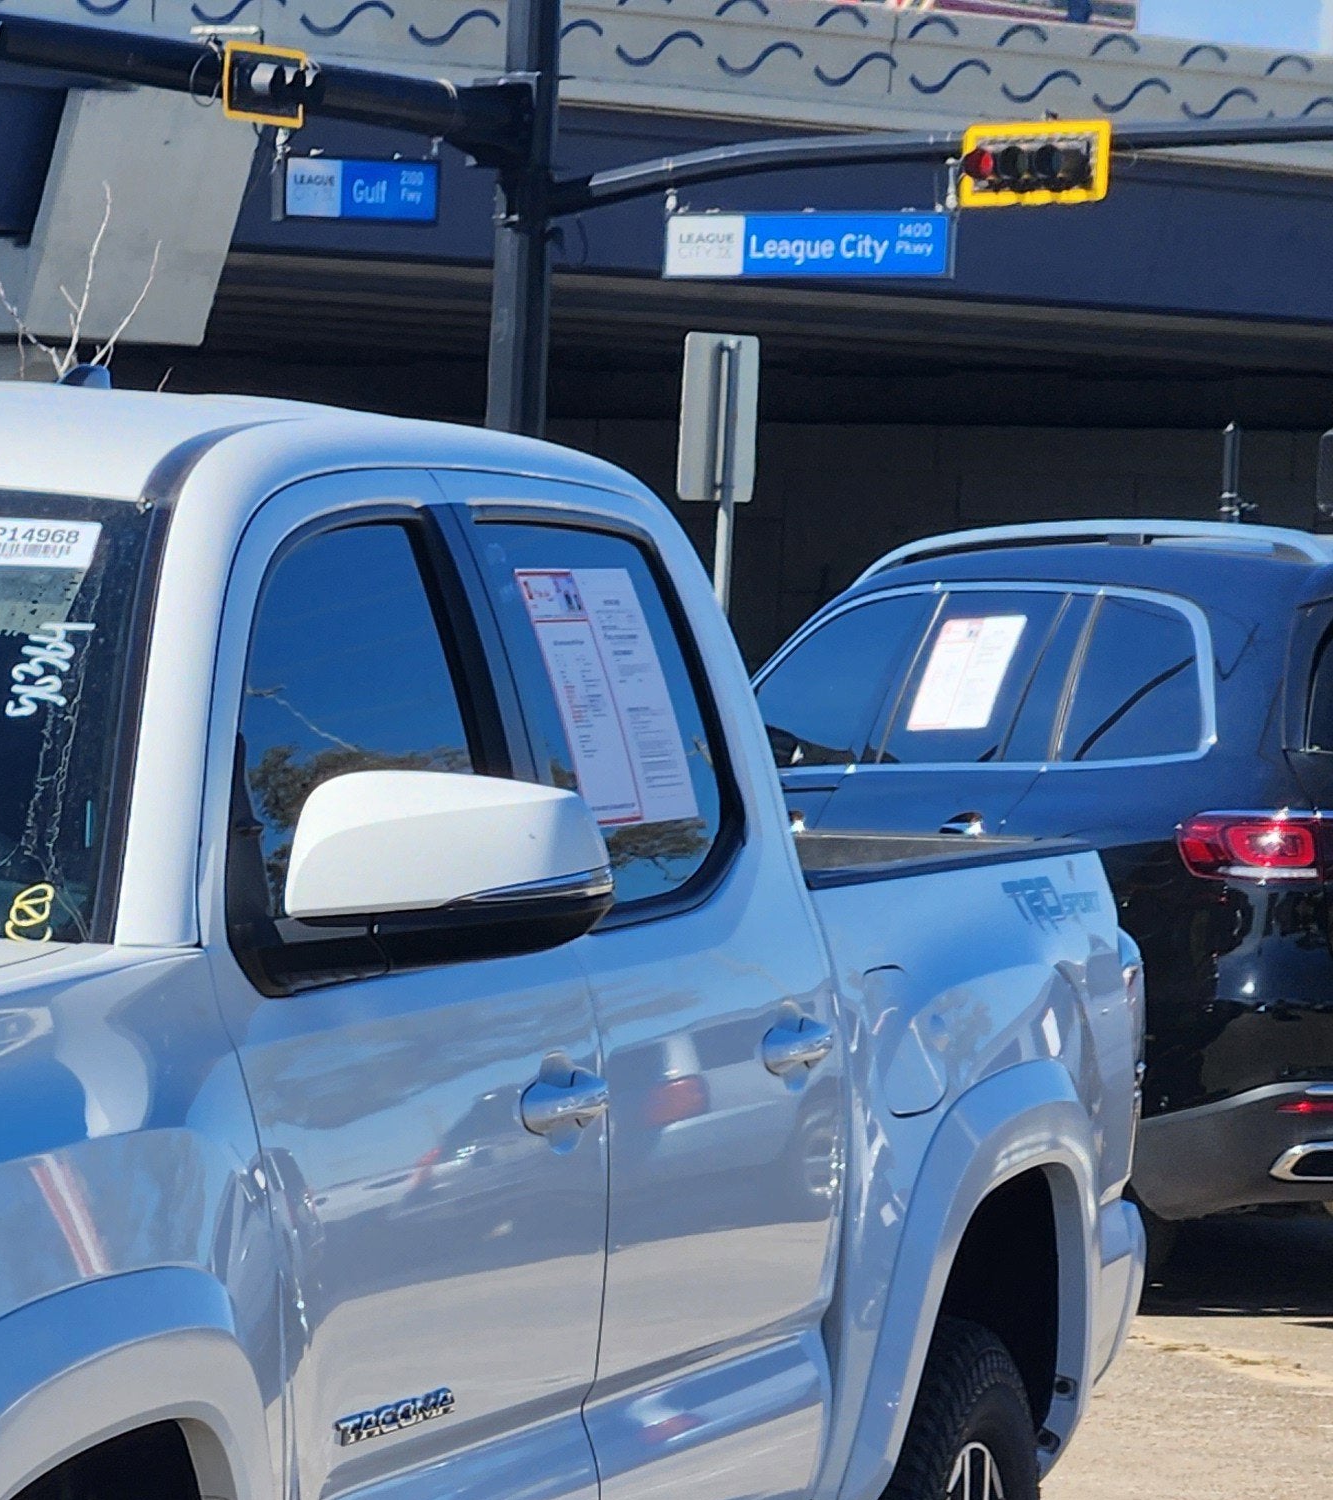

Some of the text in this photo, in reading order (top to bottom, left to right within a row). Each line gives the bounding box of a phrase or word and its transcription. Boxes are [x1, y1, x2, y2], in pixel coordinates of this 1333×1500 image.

[352, 178, 388, 204] Gulf
[400, 188, 422, 205] Fwy
[678, 232, 735, 244] LEAGUE
[897, 222, 933, 238] 1400
[749, 233, 889, 266] League City
[894, 240, 933, 257] Pkwy
[1001, 876, 1066, 934] TRD
[333, 1387, 455, 1447] TACOMA
